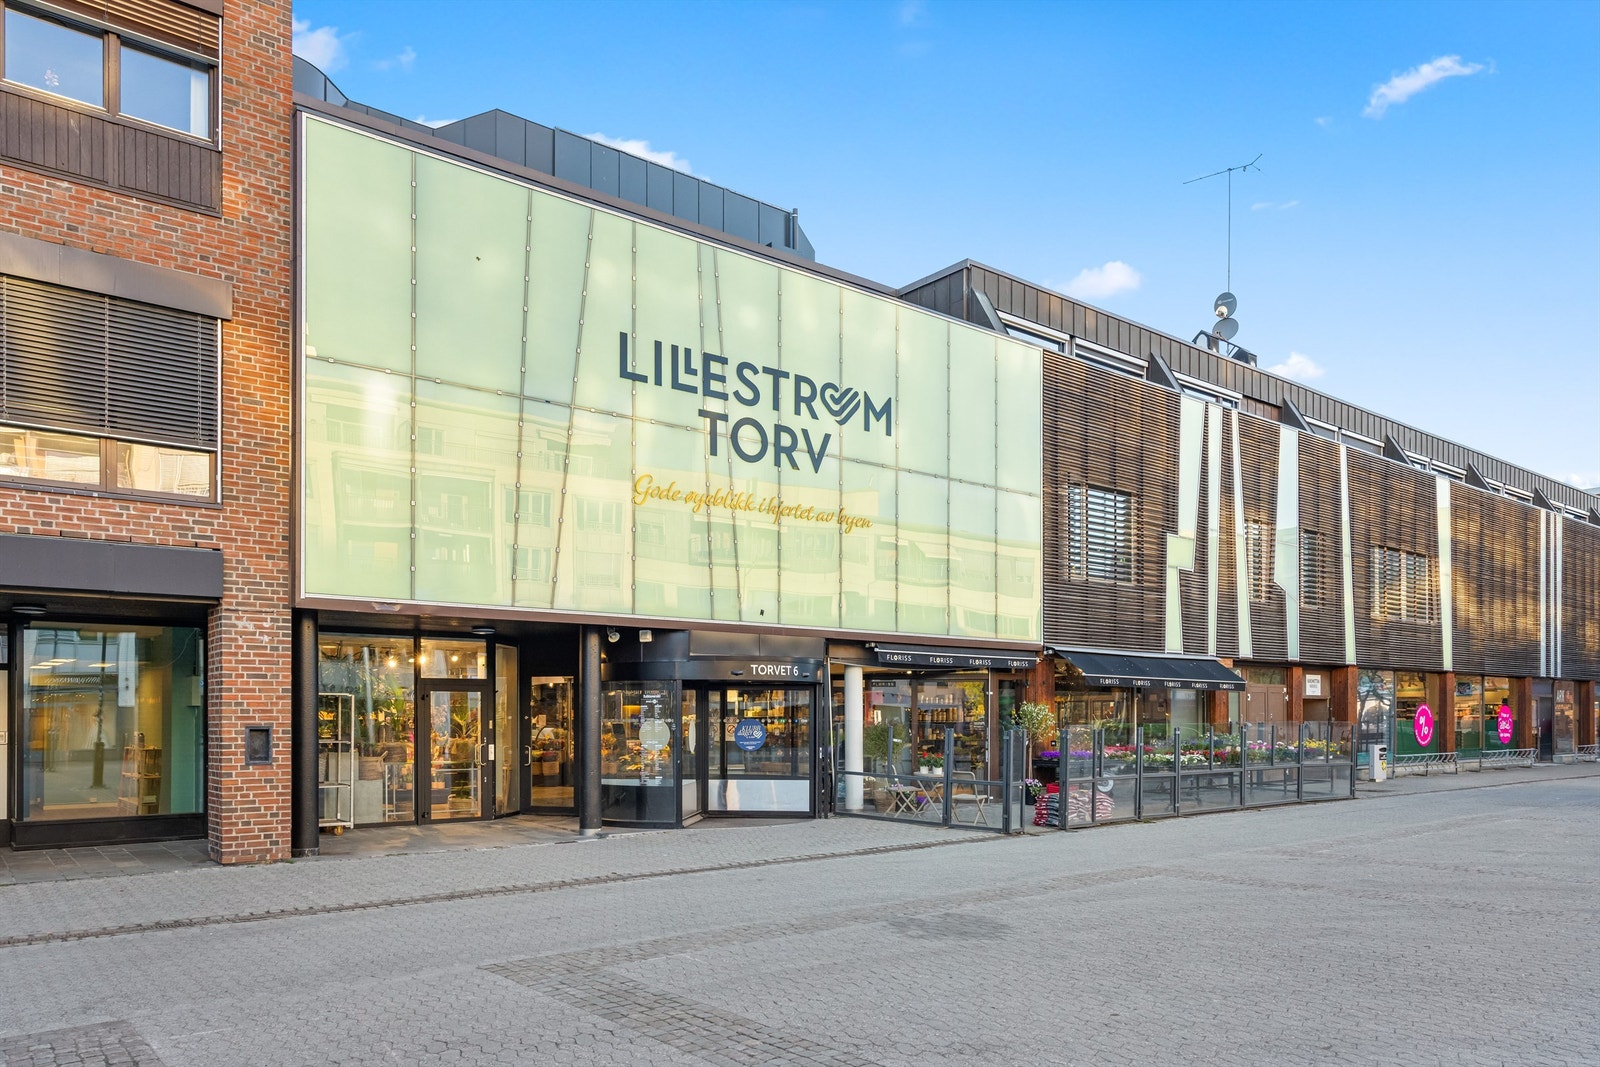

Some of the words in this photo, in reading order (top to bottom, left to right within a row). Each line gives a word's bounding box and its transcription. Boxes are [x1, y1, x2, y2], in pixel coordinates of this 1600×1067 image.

[698, 408, 832, 474] TORV
[632, 473, 681, 506] Gode
[684, 487, 756, 514] øyeblikk
[757, 496, 767, 512] i
[765, 496, 815, 525] hjertet
[815, 510, 835, 522] av
[836, 507, 873, 534] byen
[886, 654, 912, 662] FLORISS
[929, 656, 954, 664] FLORISS
[969, 658, 992, 666] FLORISS
[750, 664, 792, 676] TORVET
[793, 665, 799, 677] 6
[1132, 679, 1151, 687] FLORISS
